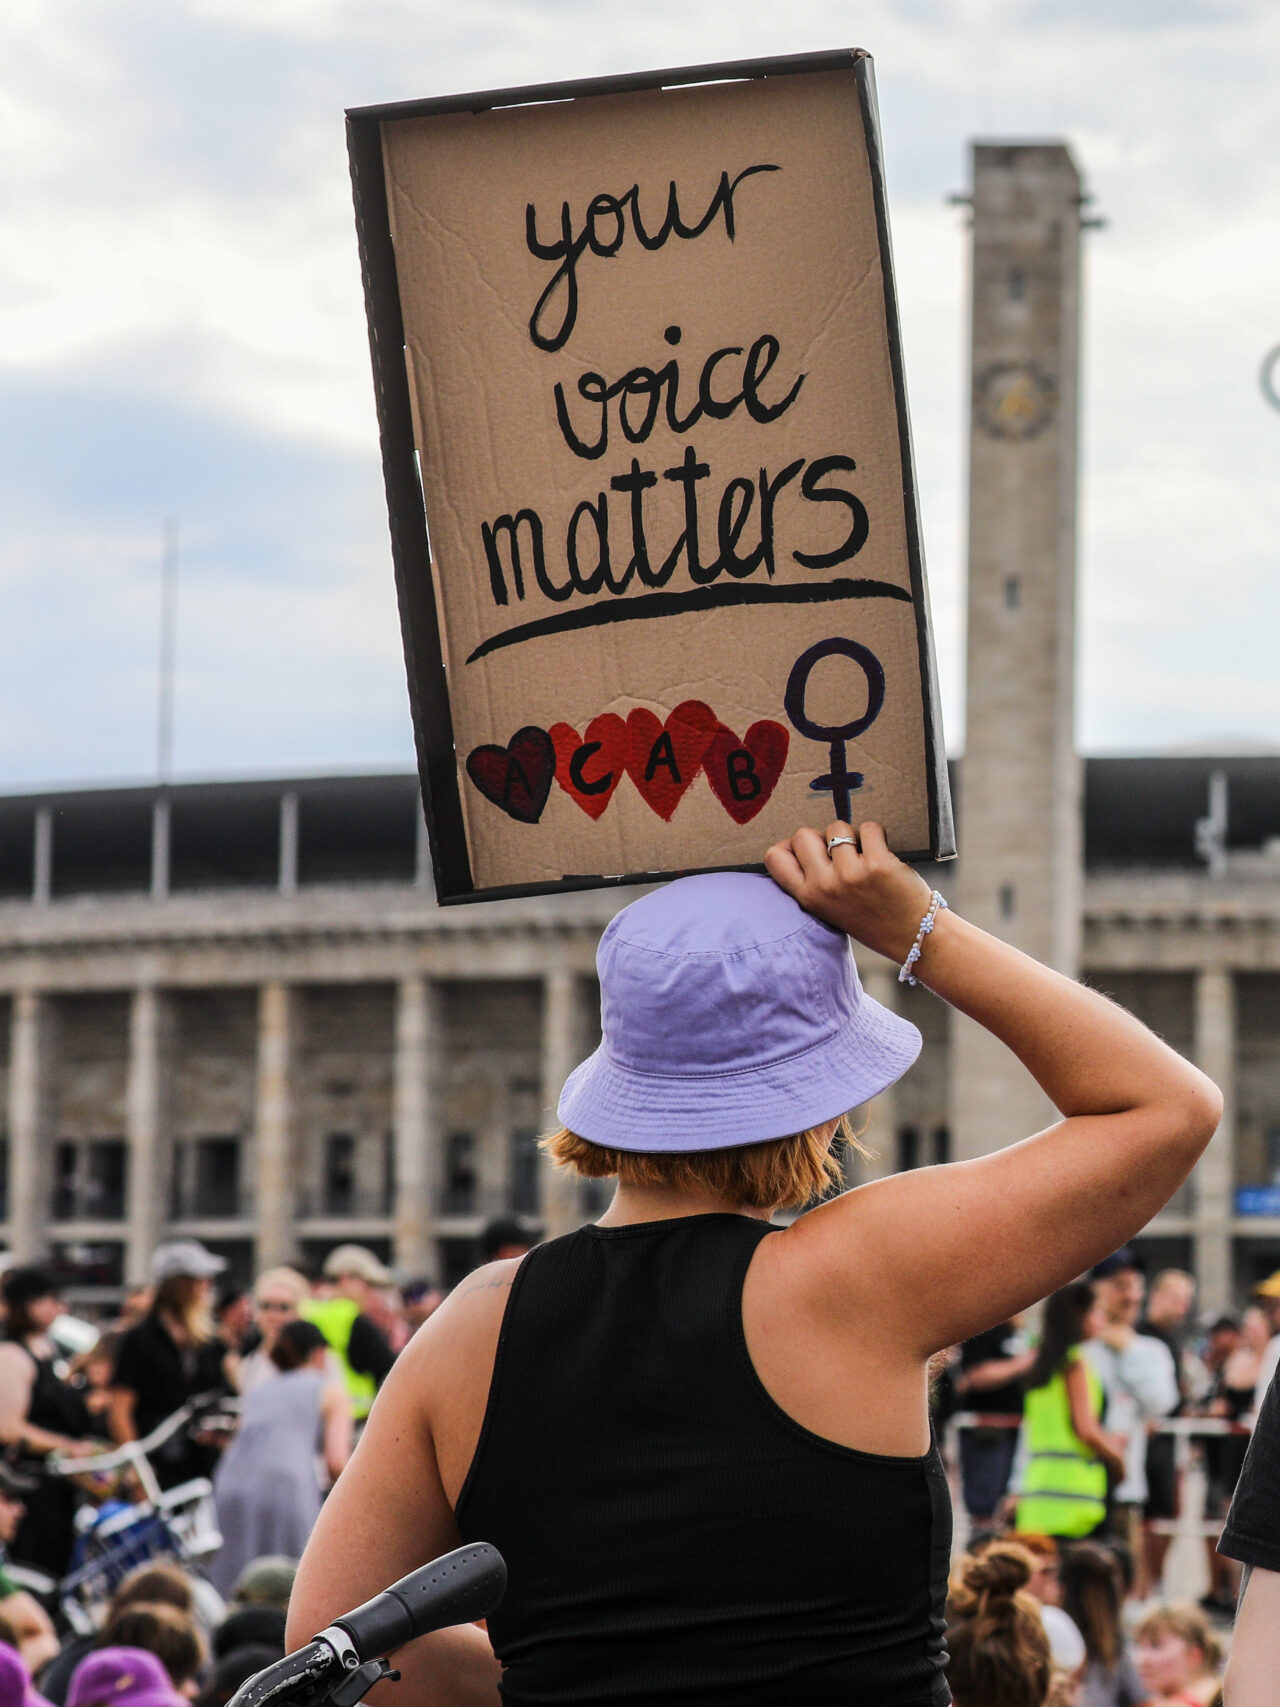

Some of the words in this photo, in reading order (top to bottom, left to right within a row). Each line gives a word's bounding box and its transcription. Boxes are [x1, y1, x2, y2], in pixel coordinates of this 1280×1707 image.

[525, 163, 784, 352] your
[554, 326, 810, 460] voice
[481, 446, 871, 605] matters
